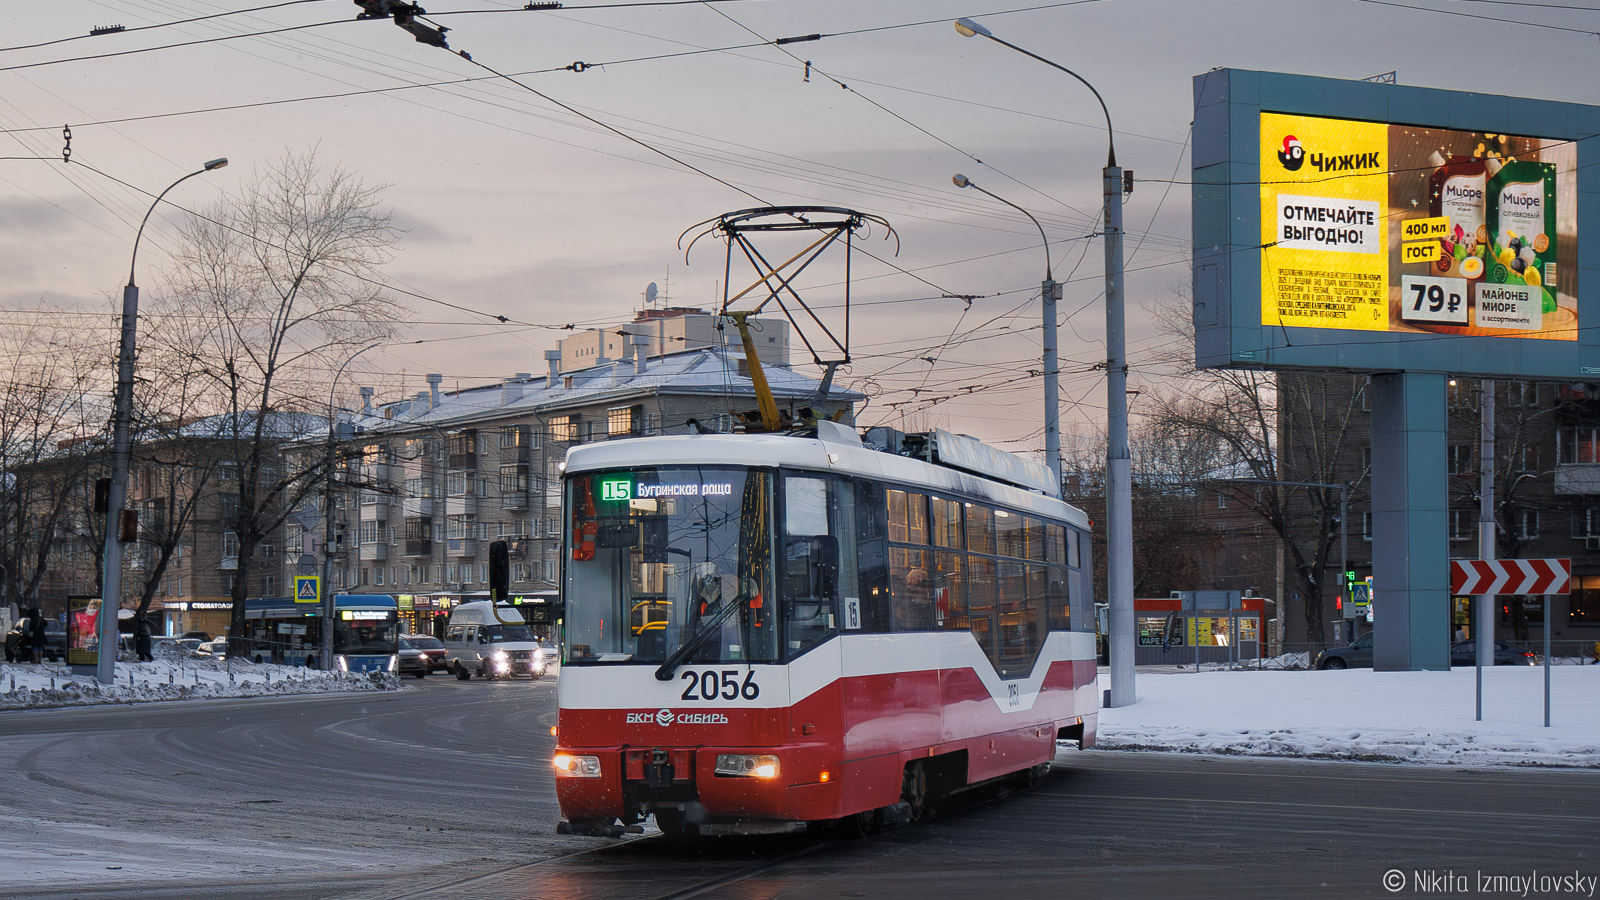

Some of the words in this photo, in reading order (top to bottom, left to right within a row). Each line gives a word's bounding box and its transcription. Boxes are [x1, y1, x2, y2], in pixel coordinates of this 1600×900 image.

[1310, 151, 1380, 172] Чижик
[1446, 184, 1482, 201] Миоре
[1503, 192, 1540, 209] Миоре
[1283, 205, 1374, 226] ОТМЕЧАЙТЕ
[1283, 225, 1364, 245] ВЫГОДНО!
[1405, 223, 1428, 236] 400
[1431, 223, 1446, 234] мл
[1407, 246, 1435, 258] ГОСТ
[1481, 288, 1529, 301] МАЙОНЕЗ
[1481, 302, 1517, 313] МИОРЕ
[1487, 316, 1531, 325] ассортименте
[604, 482, 629, 499] 15
[638, 483, 698, 497] Бугринская
[701, 483, 732, 496] роща
[848, 601, 858, 627] 15
[1140, 637, 1160, 645] VAPE
[1160, 637, 1182, 645] SOP
[680, 669, 760, 701] 2056
[626, 712, 654, 724] БКМ
[676, 713, 729, 724] СИБИРЬ
